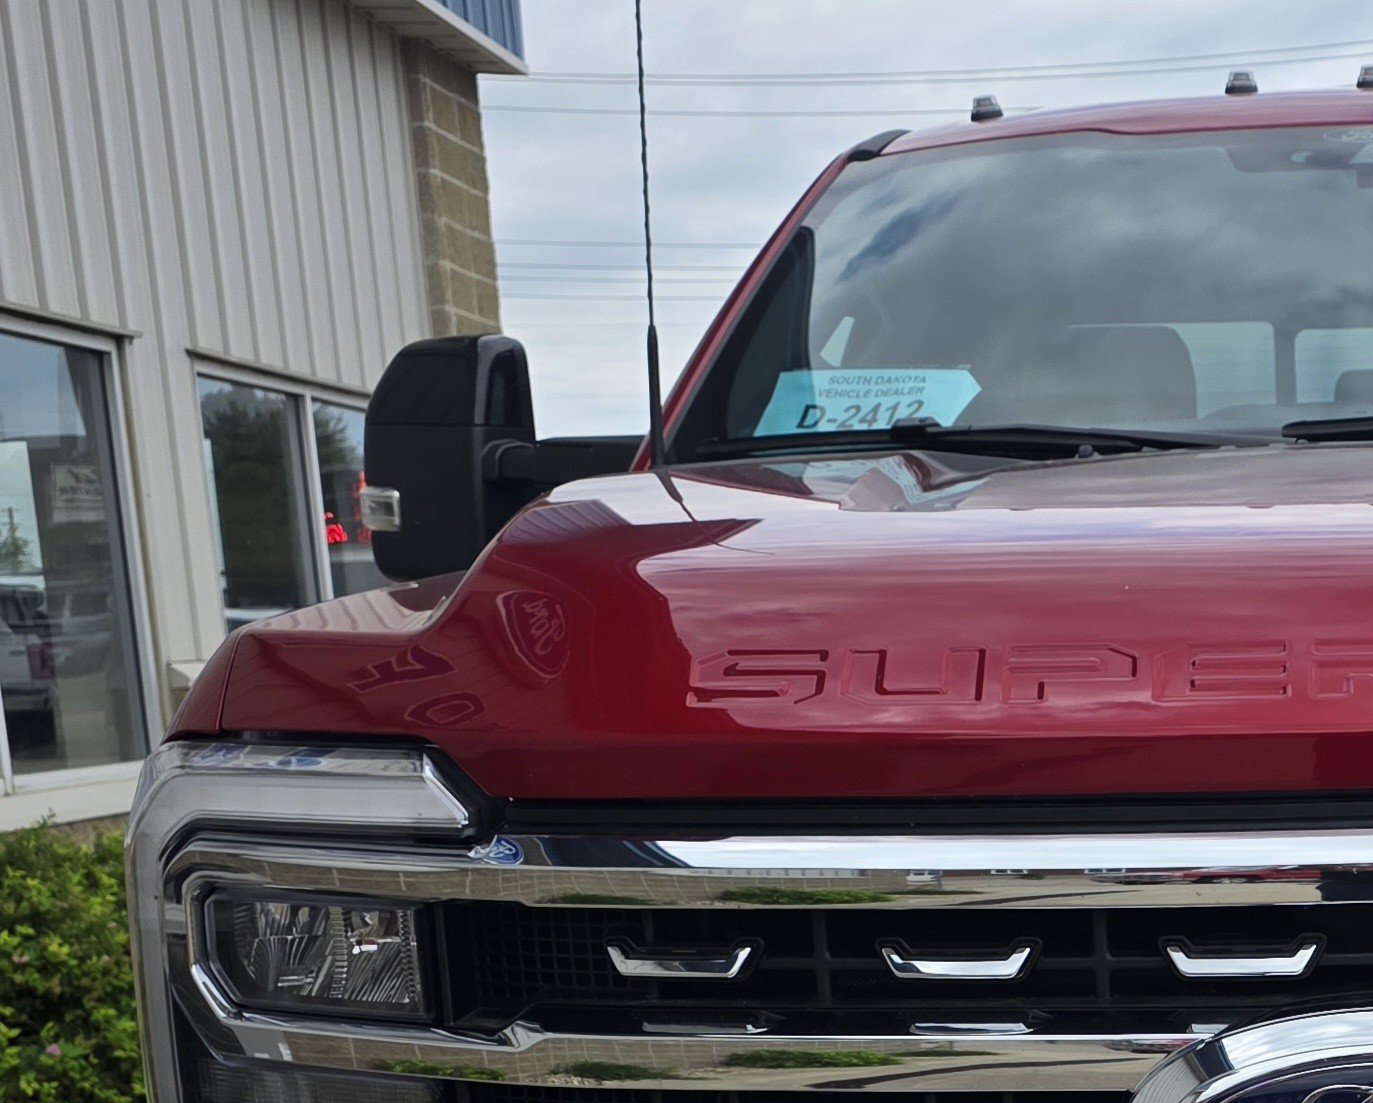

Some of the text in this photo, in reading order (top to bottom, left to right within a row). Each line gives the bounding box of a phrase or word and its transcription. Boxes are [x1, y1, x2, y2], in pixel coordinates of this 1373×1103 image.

[827, 374, 927, 386] SOUTH DAKOTA
[818, 386, 925, 399] VEHICLE DEALER
[795, 400, 924, 430] D-2412
